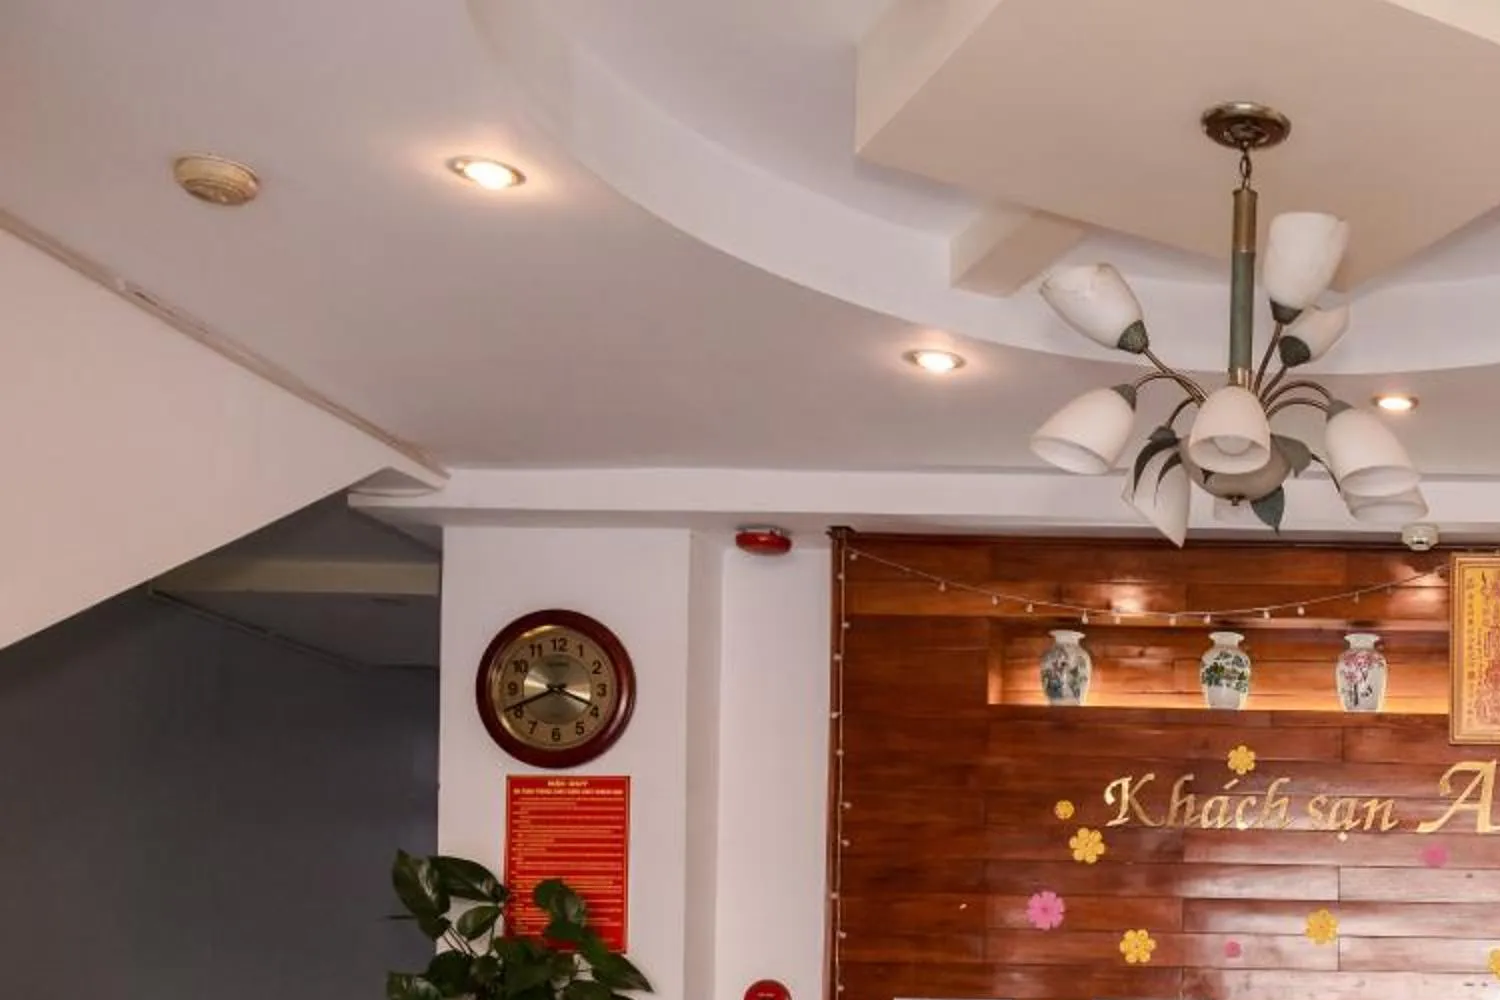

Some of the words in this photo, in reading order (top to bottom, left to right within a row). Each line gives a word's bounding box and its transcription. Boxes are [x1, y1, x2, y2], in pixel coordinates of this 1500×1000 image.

[529, 644, 543, 657] 11
[551, 638, 568, 652] 12
[578, 645, 585, 657] 1
[513, 660, 529, 674] 10
[591, 661, 602, 675] 2
[507, 682, 518, 696] 9
[596, 684, 607, 697] 3
[514, 704, 524, 719] 8
[590, 705, 599, 718] 4
[528, 722, 537, 735] 7
[551, 728, 561, 742] 6
[575, 722, 585, 735] 5
[1104, 773, 1297, 829] Khách
